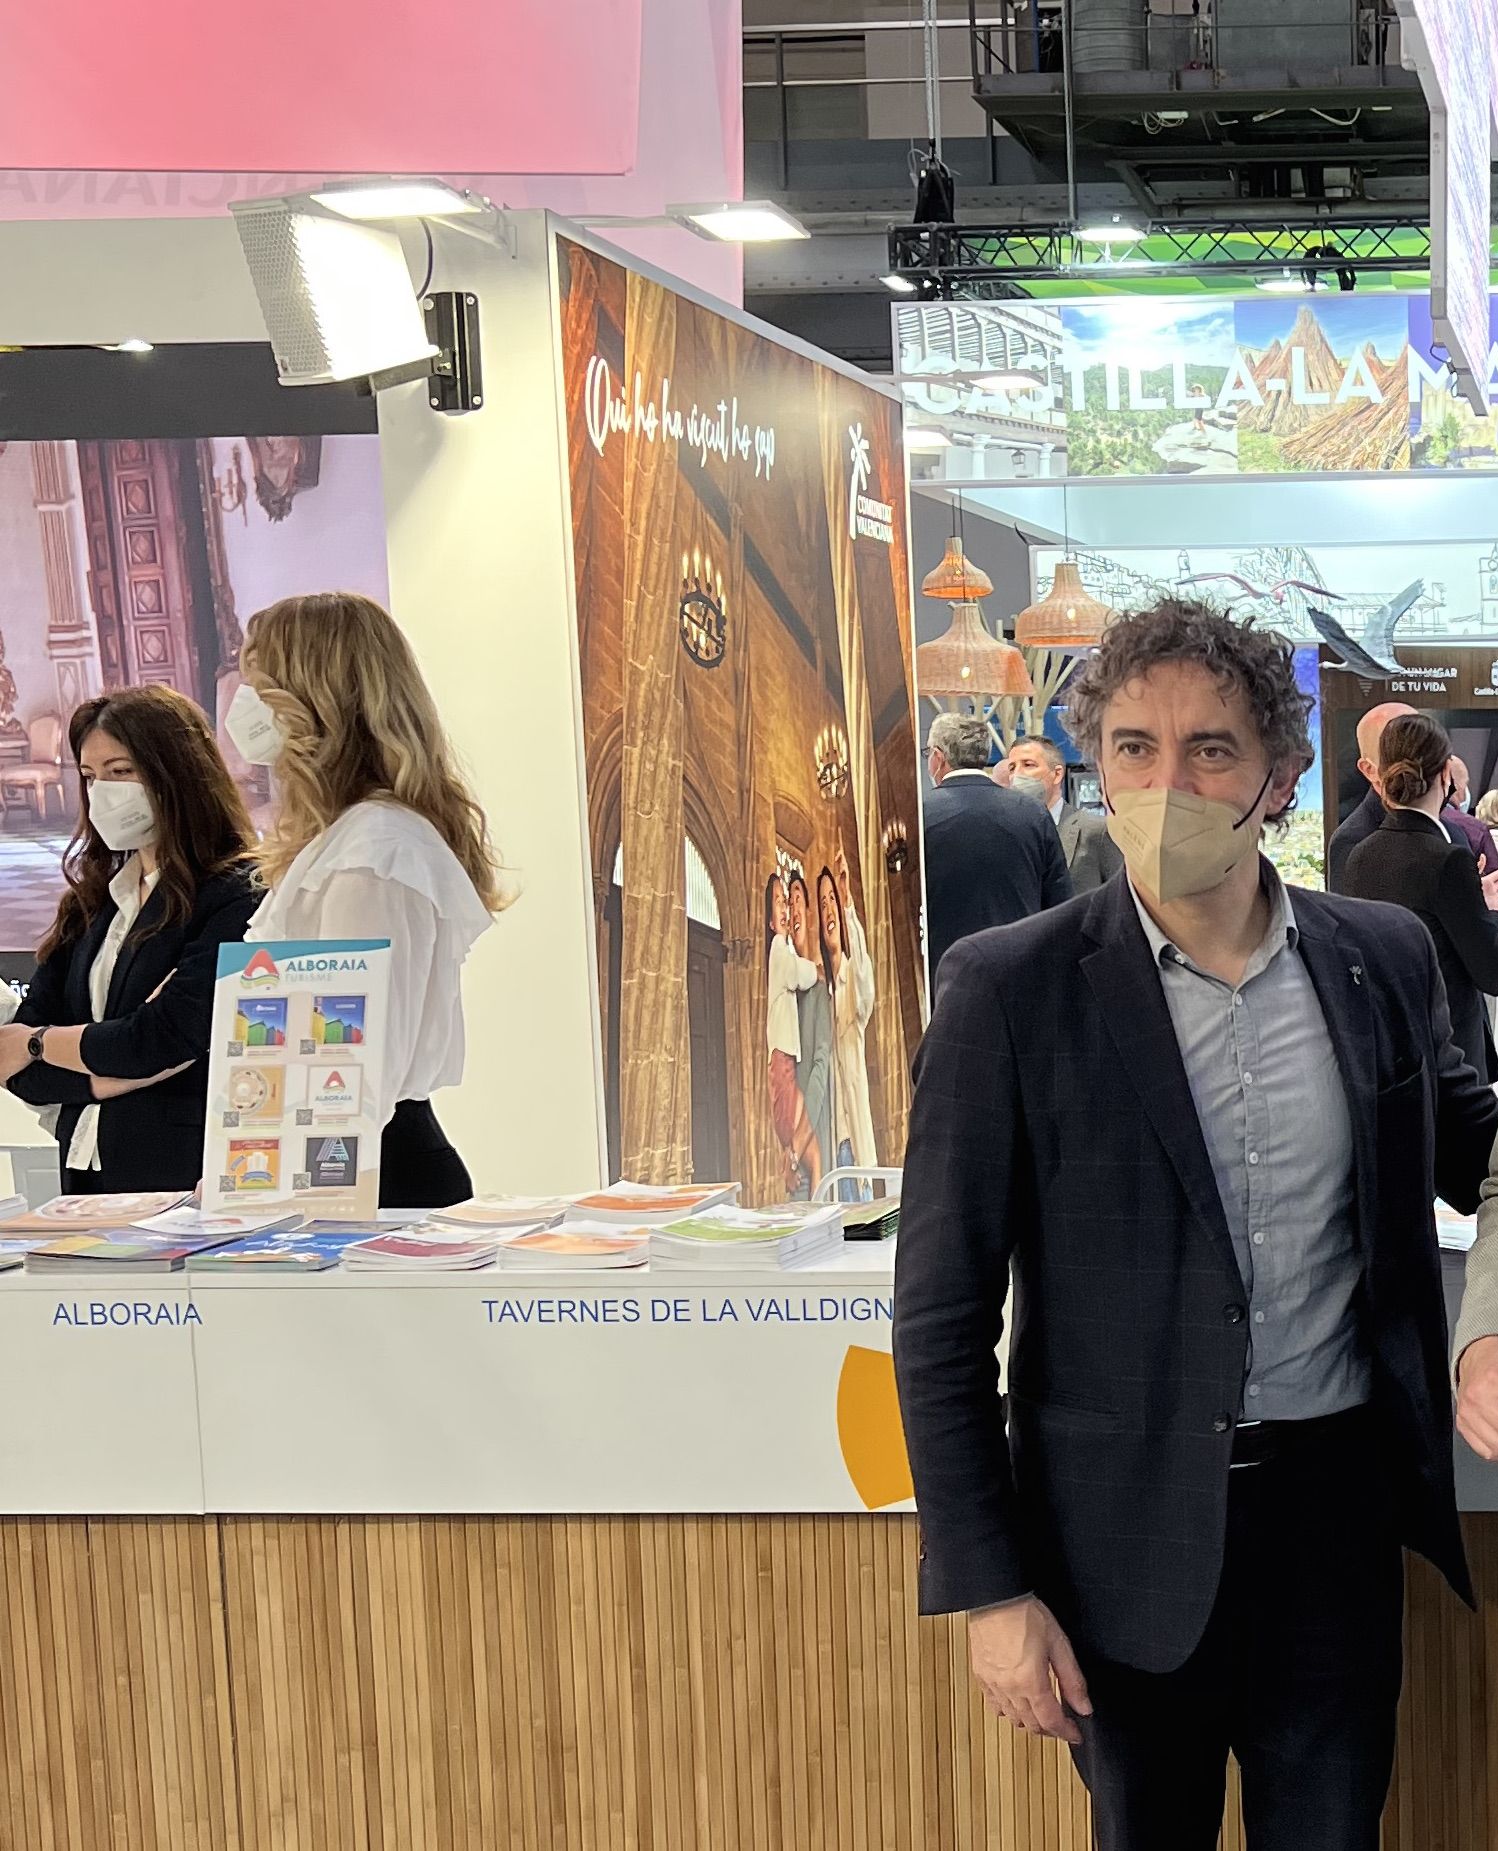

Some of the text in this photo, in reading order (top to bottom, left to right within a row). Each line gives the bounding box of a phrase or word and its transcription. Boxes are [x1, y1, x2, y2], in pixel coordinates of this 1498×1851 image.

[901, 343, 1383, 415] CASTILLA-LA
[585, 355, 631, 457] Qui
[635, 371, 659, 442] ho
[662, 377, 684, 443] ha
[732, 397, 752, 461] ho
[1391, 681, 1447, 692] DE TU VIDA
[285, 959, 368, 972] ALBORAIA
[285, 973, 333, 983] TURISME
[53, 1303, 203, 1325] ALBORAIA
[482, 1299, 641, 1323] TAVERNES
[651, 1299, 691, 1322] DE
[702, 1299, 738, 1322] LA
